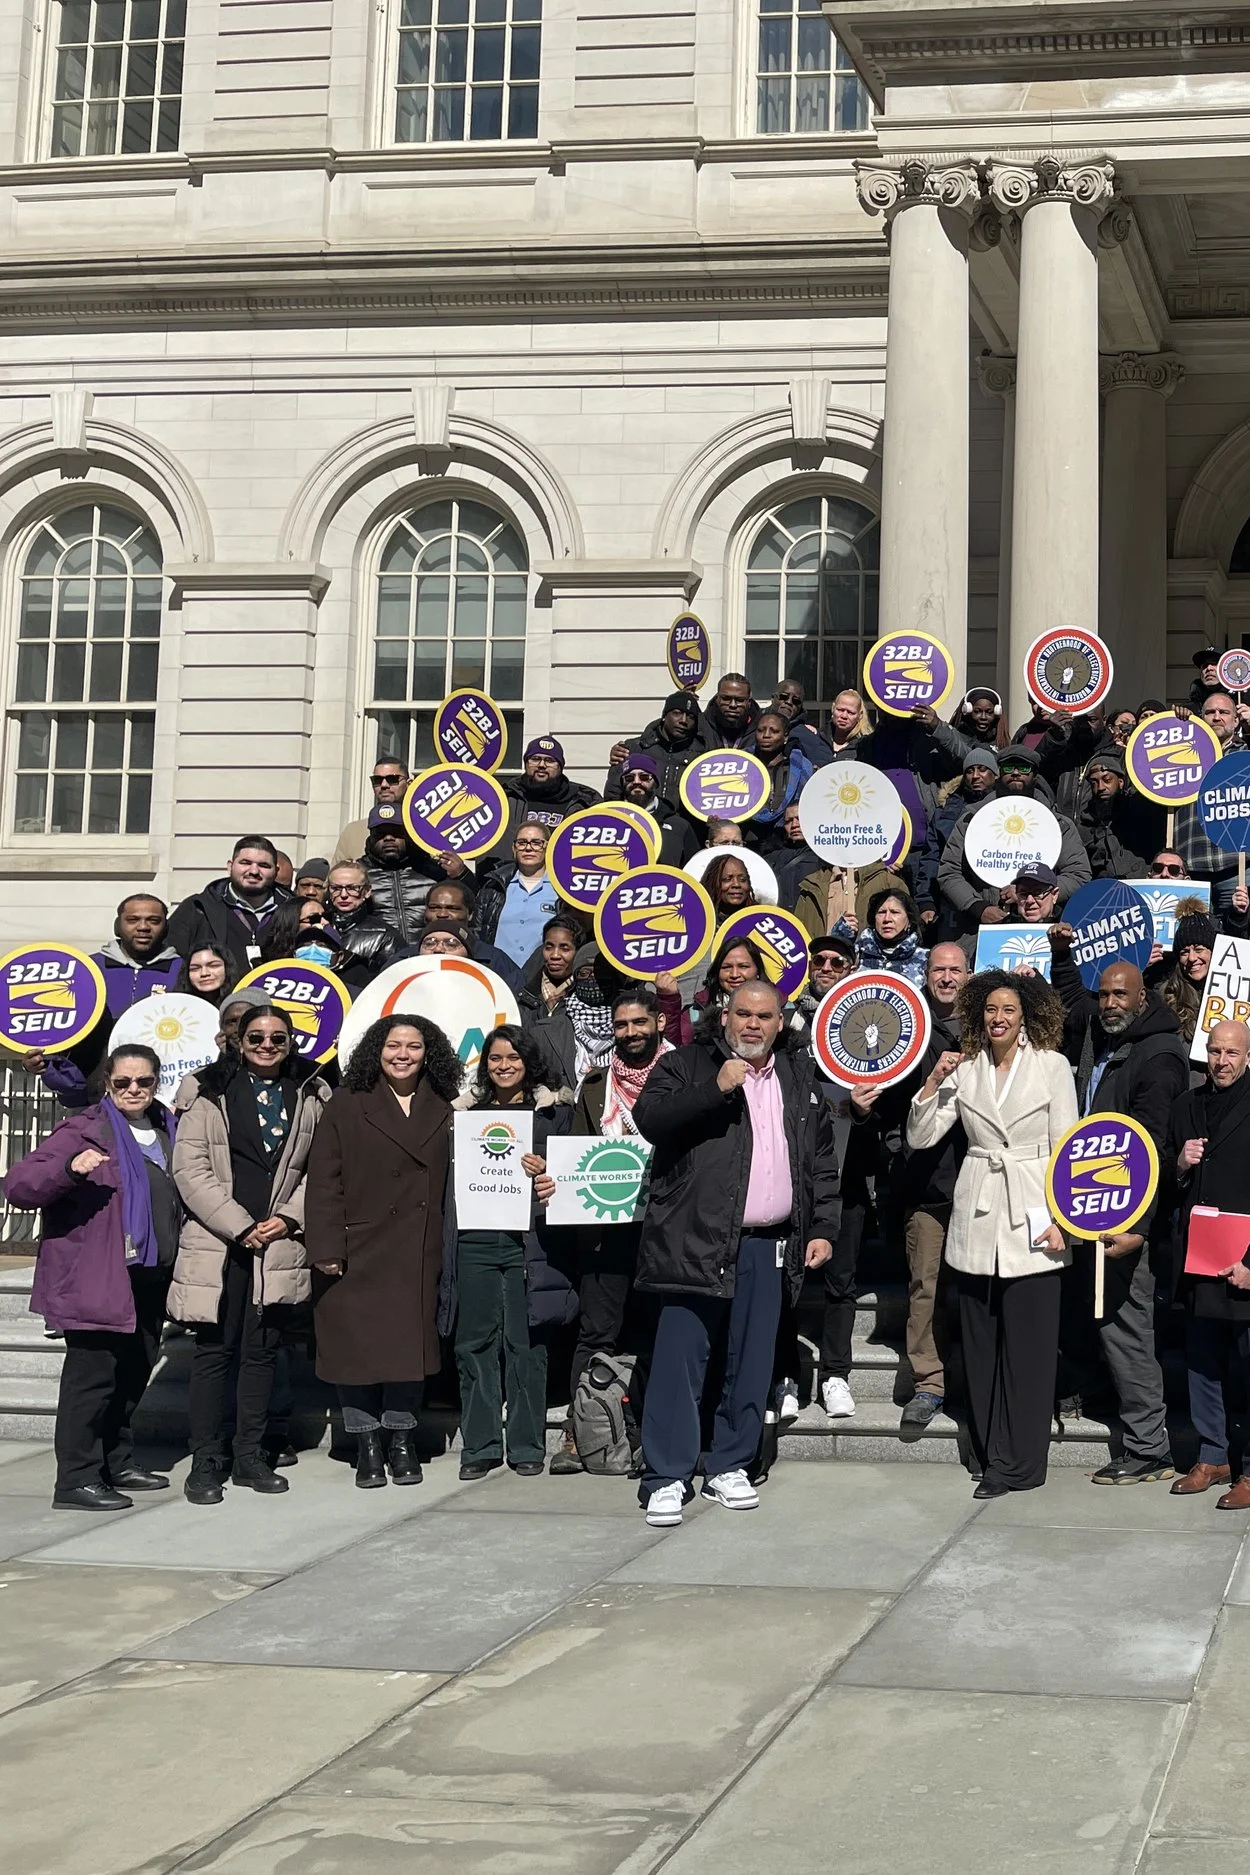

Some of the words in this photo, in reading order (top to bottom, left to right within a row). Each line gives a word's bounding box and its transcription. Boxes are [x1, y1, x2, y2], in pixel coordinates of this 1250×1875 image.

[675, 626, 700, 641] 32BJ
[882, 645, 934, 660] 32BJ
[1081, 644, 1090, 654] OF
[677, 662, 702, 677] SEIU
[883, 684, 934, 699] SEIU
[462, 698, 500, 740] 32BJ
[442, 728, 479, 766] SEIU
[1143, 723, 1195, 748] 32BJ
[698, 761, 749, 777] 32BJ
[1152, 765, 1203, 790] SEIU
[414, 771, 463, 818] 32BJ
[700, 795, 750, 810] SEIU
[1204, 803, 1250, 822] JOBS
[448, 805, 493, 850] SEIU
[569, 826, 632, 846] 32BJ
[818, 824, 852, 834] Carbon
[853, 824, 874, 834] Free
[876, 824, 883, 834] &
[813, 835, 851, 848] Healthy
[852, 835, 888, 846] Schools
[976, 859, 1011, 871] Healthy
[981, 849, 1013, 860] Carbon
[1014, 851, 1034, 860] Free
[1035, 852, 1042, 861] &
[617, 883, 684, 909] 32BJ
[1069, 905, 1143, 949] CLIMATE
[1153, 915, 1178, 939] FT
[624, 935, 688, 960] SEIU
[755, 917, 805, 963] 32BJ
[1073, 935, 1119, 967] JOBS
[1121, 923, 1146, 947] NY
[1218, 941, 1242, 970] A
[6, 960, 77, 984] 32BJ
[263, 976, 331, 1003] 32BJ
[879, 989, 890, 1001] OF
[833, 988, 877, 1025] BROTHERHOOD
[889, 994, 912, 1036] ELECTRICAL
[8, 1010, 77, 1034] SEIU
[829, 1027, 868, 1071] INTERNATIONAL
[877, 1039, 909, 1069] WORKERS
[178, 1059, 202, 1071] Free
[205, 1055, 213, 1065] &
[1069, 1131, 1132, 1160] 32BJ
[480, 1166, 513, 1177] Create
[556, 1173, 597, 1183] CLIMATE
[599, 1173, 633, 1181] WORKS
[468, 1182, 497, 1193] Good
[498, 1183, 522, 1195] Jobs
[1069, 1188, 1132, 1217] SEIU
